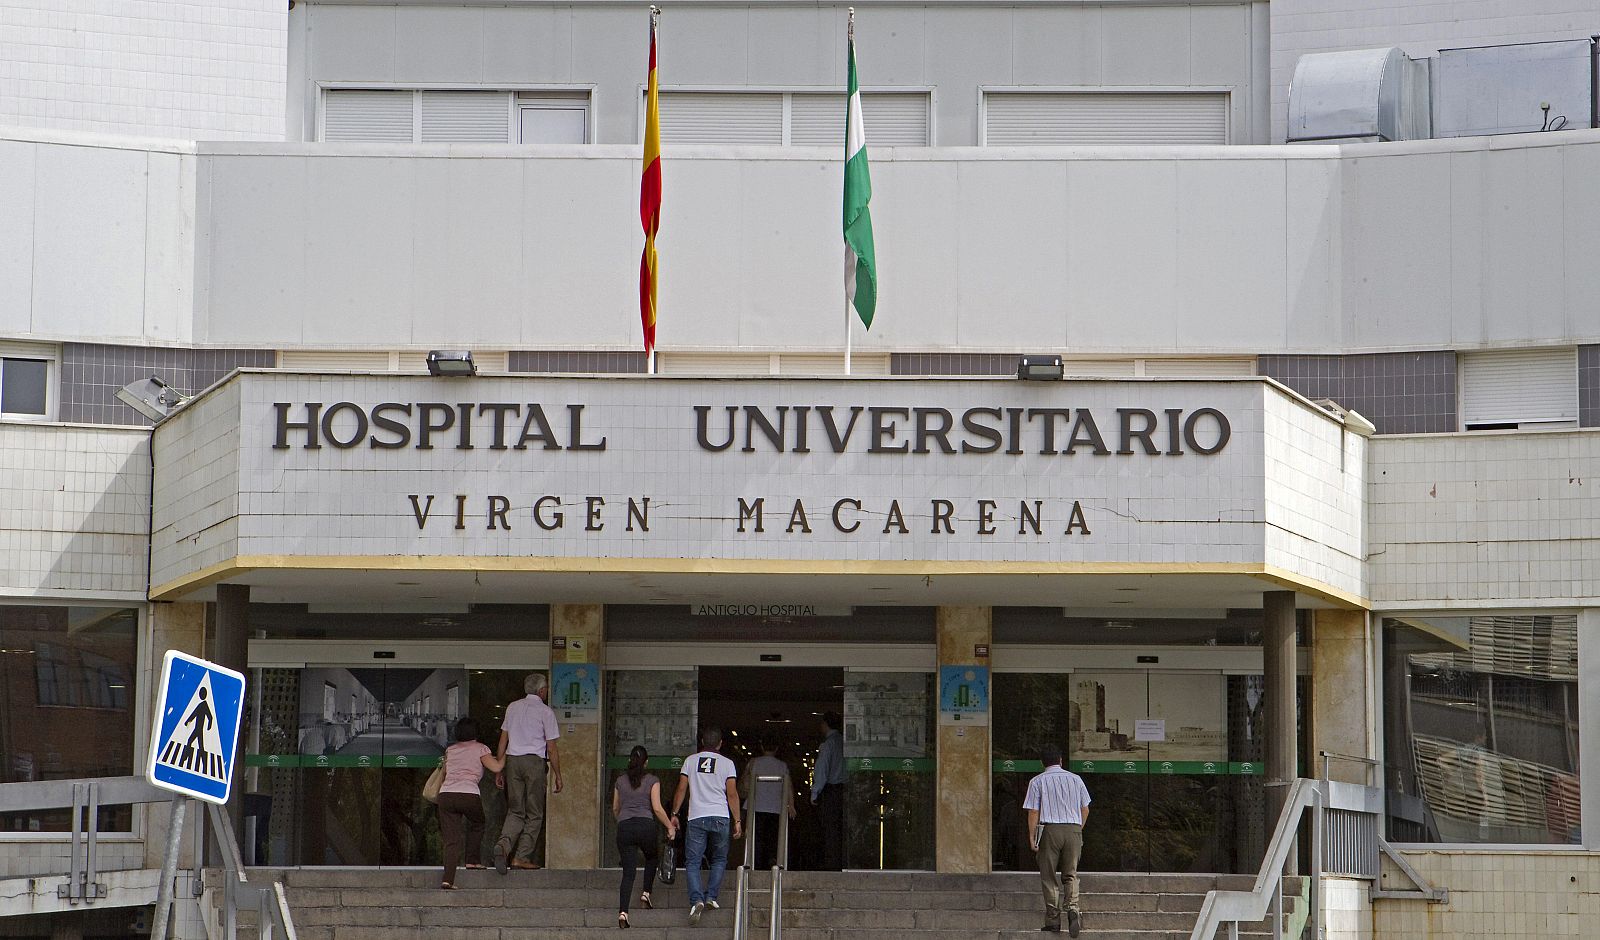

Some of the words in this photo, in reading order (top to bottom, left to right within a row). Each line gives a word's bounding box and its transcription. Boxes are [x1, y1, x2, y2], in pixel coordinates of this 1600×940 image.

[272, 402, 607, 451] HOSPITAL
[694, 405, 1231, 457] UNIVERSITARIO
[405, 494, 650, 532] VIRGEN
[737, 497, 1092, 536] MACARENA
[698, 604, 757, 616] ANTIGUO
[760, 604, 817, 616] HOSPITAL
[700, 757, 712, 773] 4
